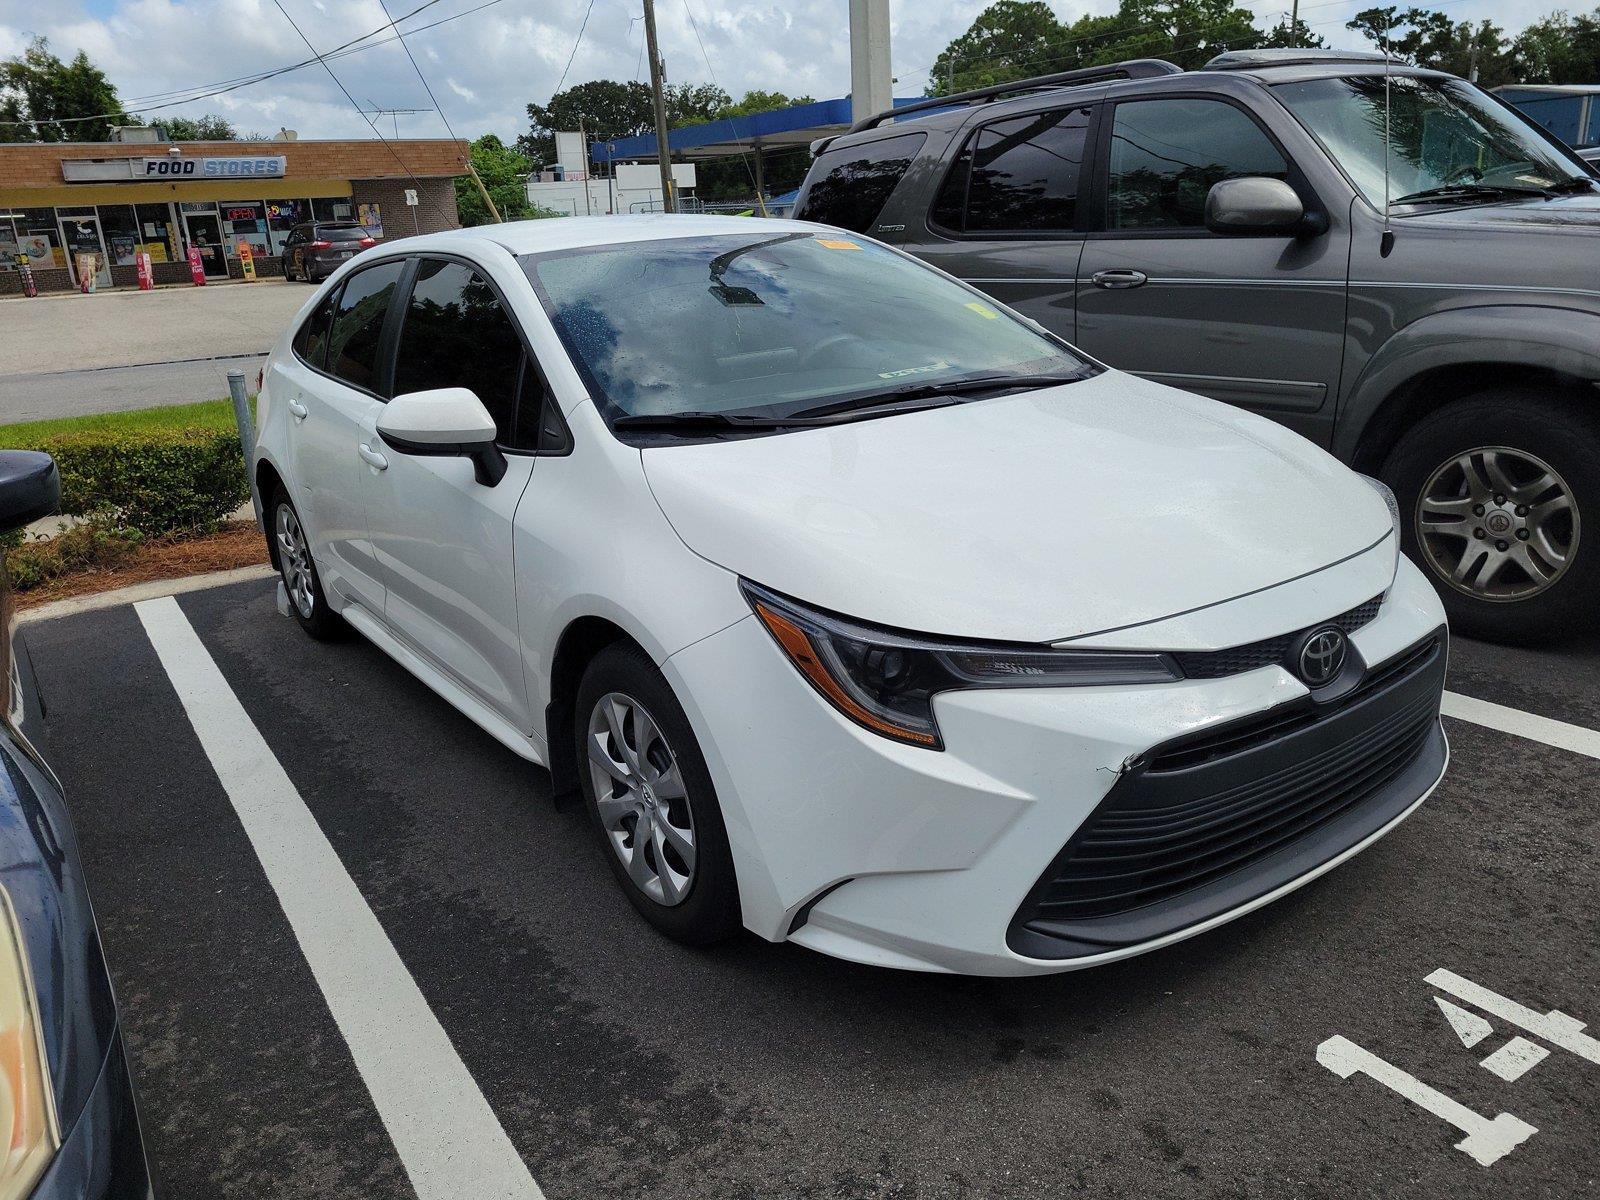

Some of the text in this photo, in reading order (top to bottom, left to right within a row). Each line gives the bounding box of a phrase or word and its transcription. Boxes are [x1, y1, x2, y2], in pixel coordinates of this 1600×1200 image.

[146, 160, 279, 175] FOOD STORES
[228, 207, 256, 219] OPEN
